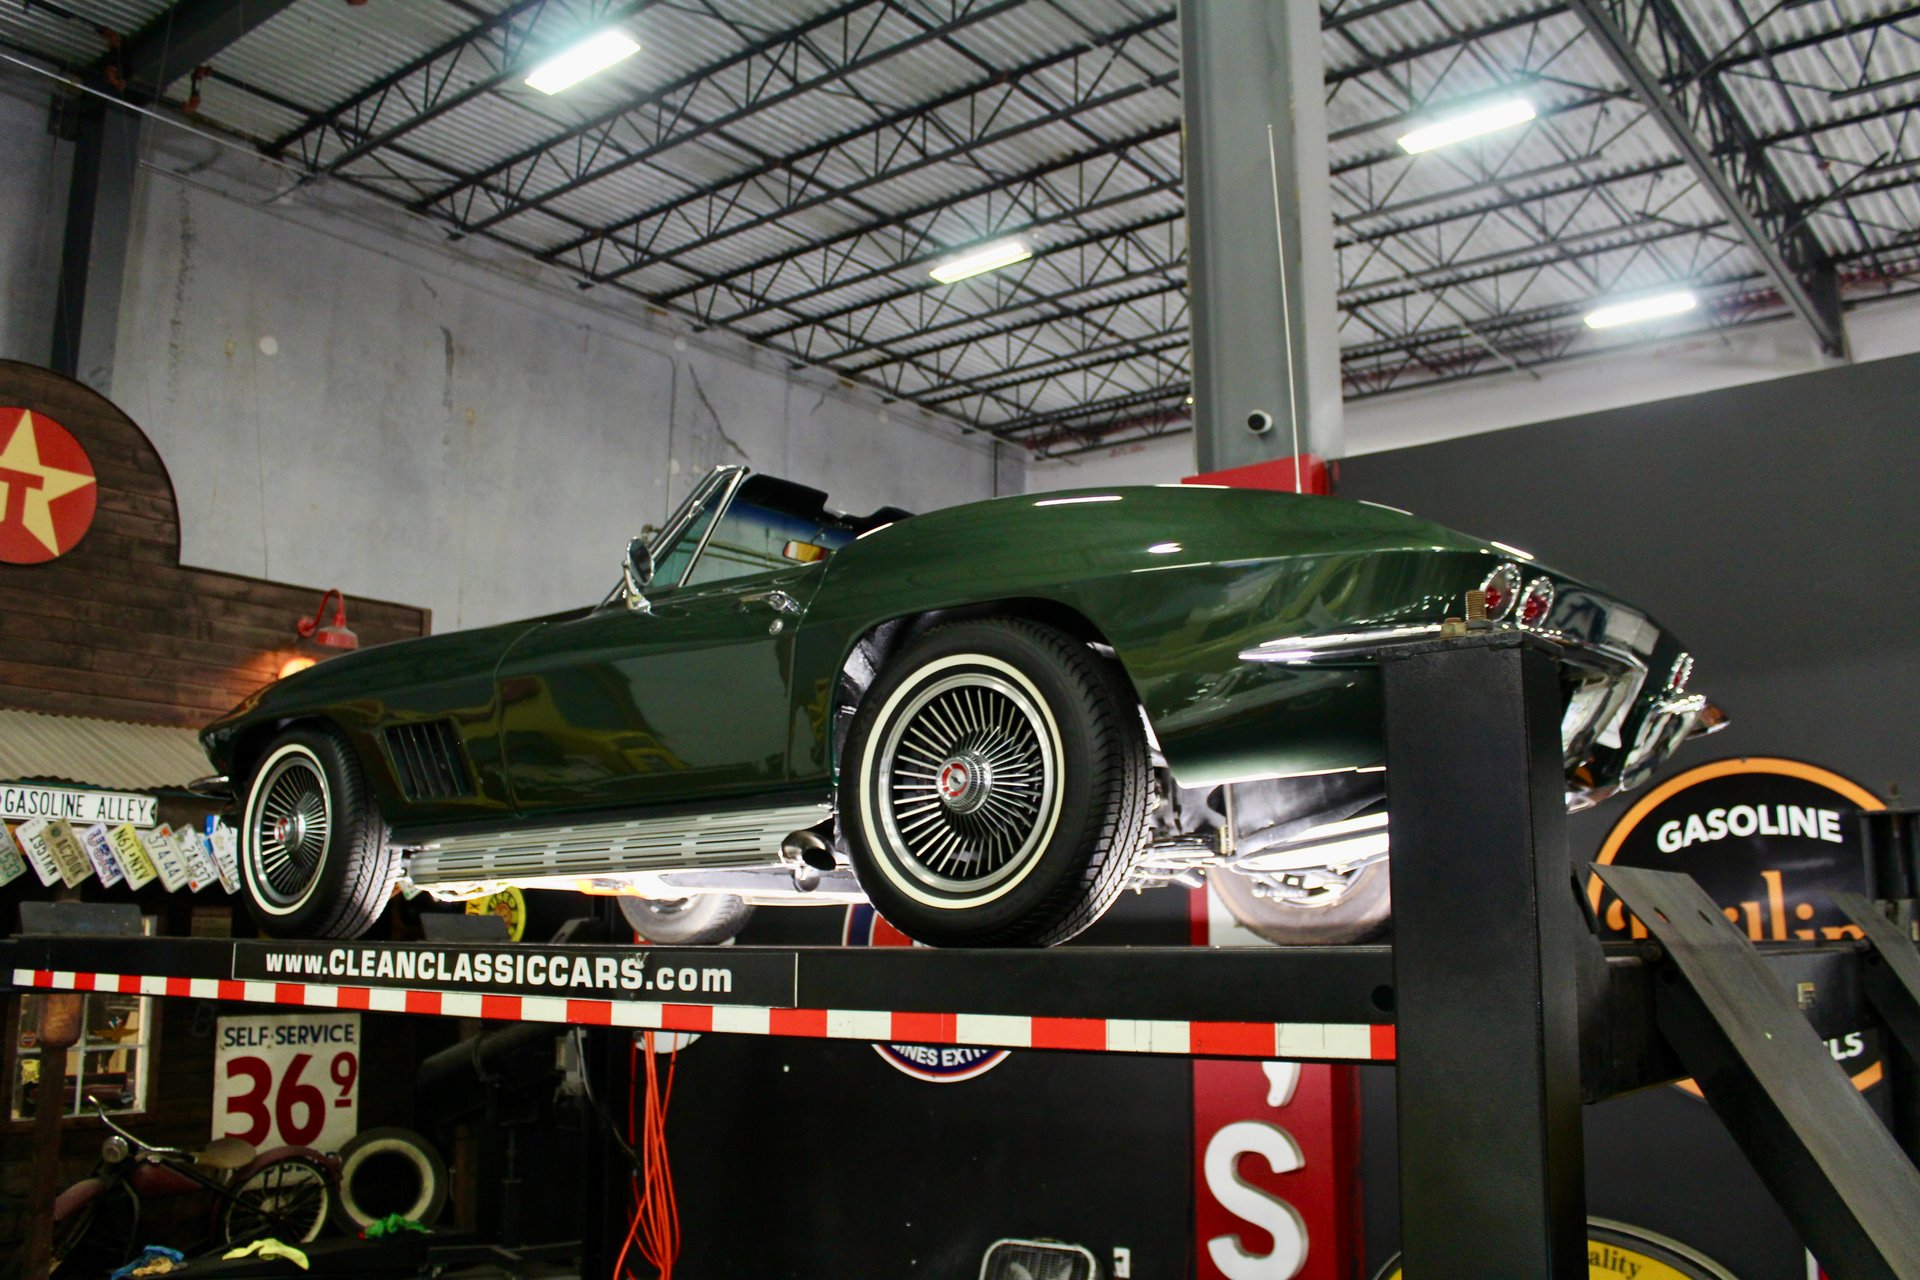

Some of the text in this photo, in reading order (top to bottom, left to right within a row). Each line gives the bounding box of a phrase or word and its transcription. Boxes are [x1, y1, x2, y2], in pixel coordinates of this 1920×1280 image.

[5, 789, 147, 822] GASOLINE ALLEY
[1657, 804, 1843, 853] GASOLINE
[265, 948, 733, 993] www.CLEANCLASSICCARS.com
[275, 1024, 354, 1045] SERVICE
[1822, 1031, 1864, 1061] LS
[1588, 1248, 1642, 1280] ality
